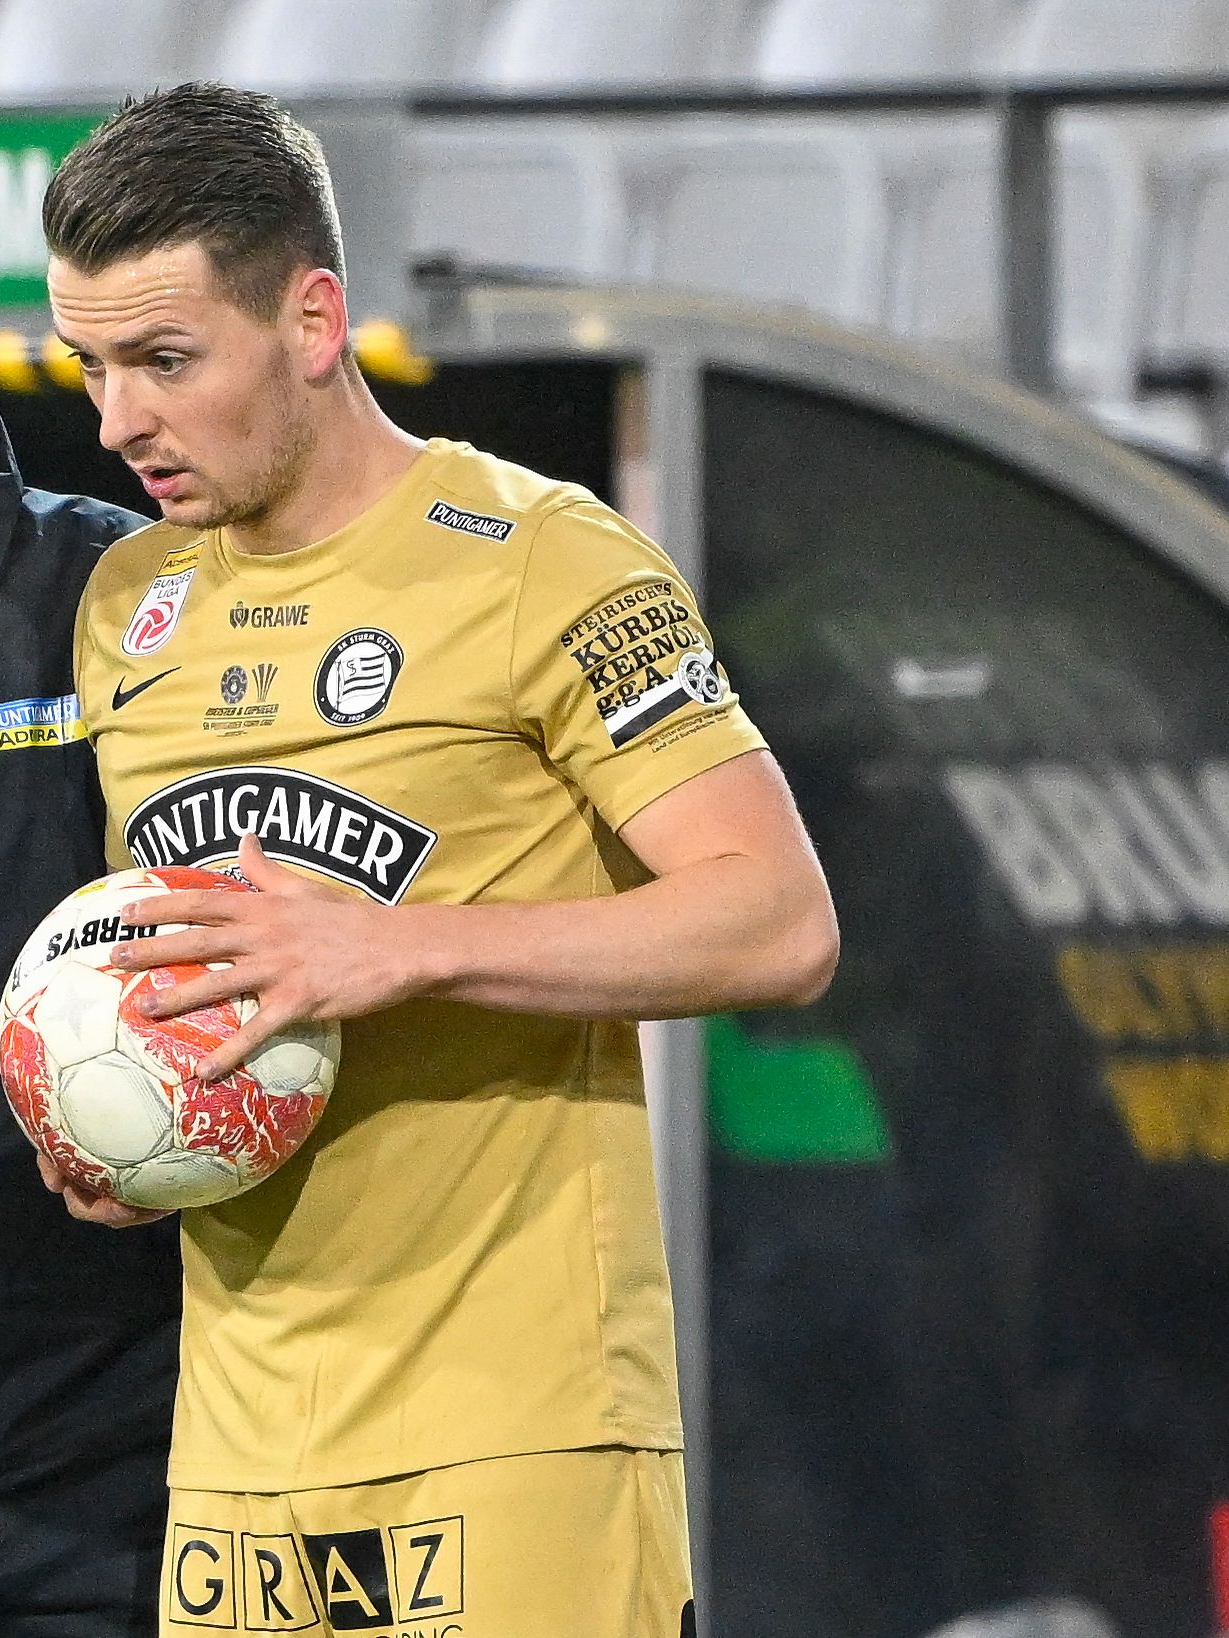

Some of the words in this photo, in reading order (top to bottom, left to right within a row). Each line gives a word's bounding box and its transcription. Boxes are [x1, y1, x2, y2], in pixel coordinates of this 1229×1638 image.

[431, 504, 508, 538] PUNTIGAMER
[153, 571, 192, 589] BUNDES
[157, 587, 179, 599] LIGA
[251, 605, 310, 628] GRAWE
[560, 582, 672, 648] STEIRISCHES
[570, 599, 689, 673] KÜRBIS
[349, 633, 375, 645] STURM
[376, 636, 396, 654] GRAZ
[586, 625, 701, 694] KERNÖL
[596, 665, 674, 720] g.g.A.
[176, 1533, 444, 1621] GRAZ
